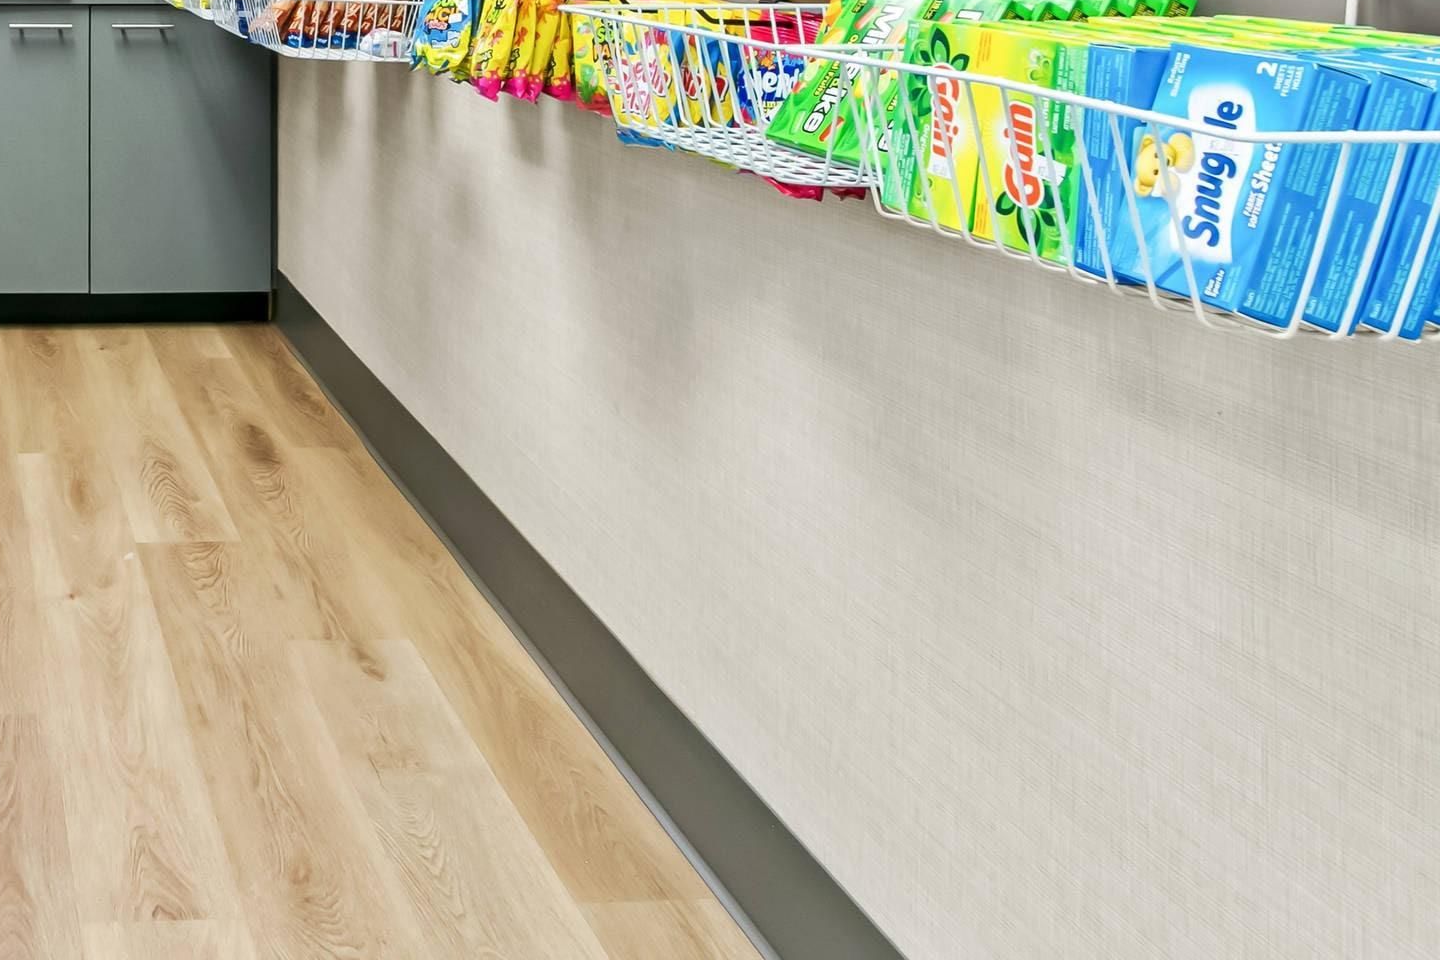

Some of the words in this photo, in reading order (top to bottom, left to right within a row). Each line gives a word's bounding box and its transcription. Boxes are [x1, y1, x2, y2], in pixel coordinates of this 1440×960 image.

[1256, 61, 1278, 77] 2
[1274, 63, 1288, 91] SHEETS
[1280, 65, 1296, 98] FEUILLES
[1290, 66, 1305, 91] HOJAS
[1003, 102, 1044, 207] Gain
[1253, 143, 1284, 193] Sheet
[1181, 100, 1244, 248] Snugle
[1247, 189, 1266, 229] SOFTENER
[1211, 268, 1226, 298] Sparkle
